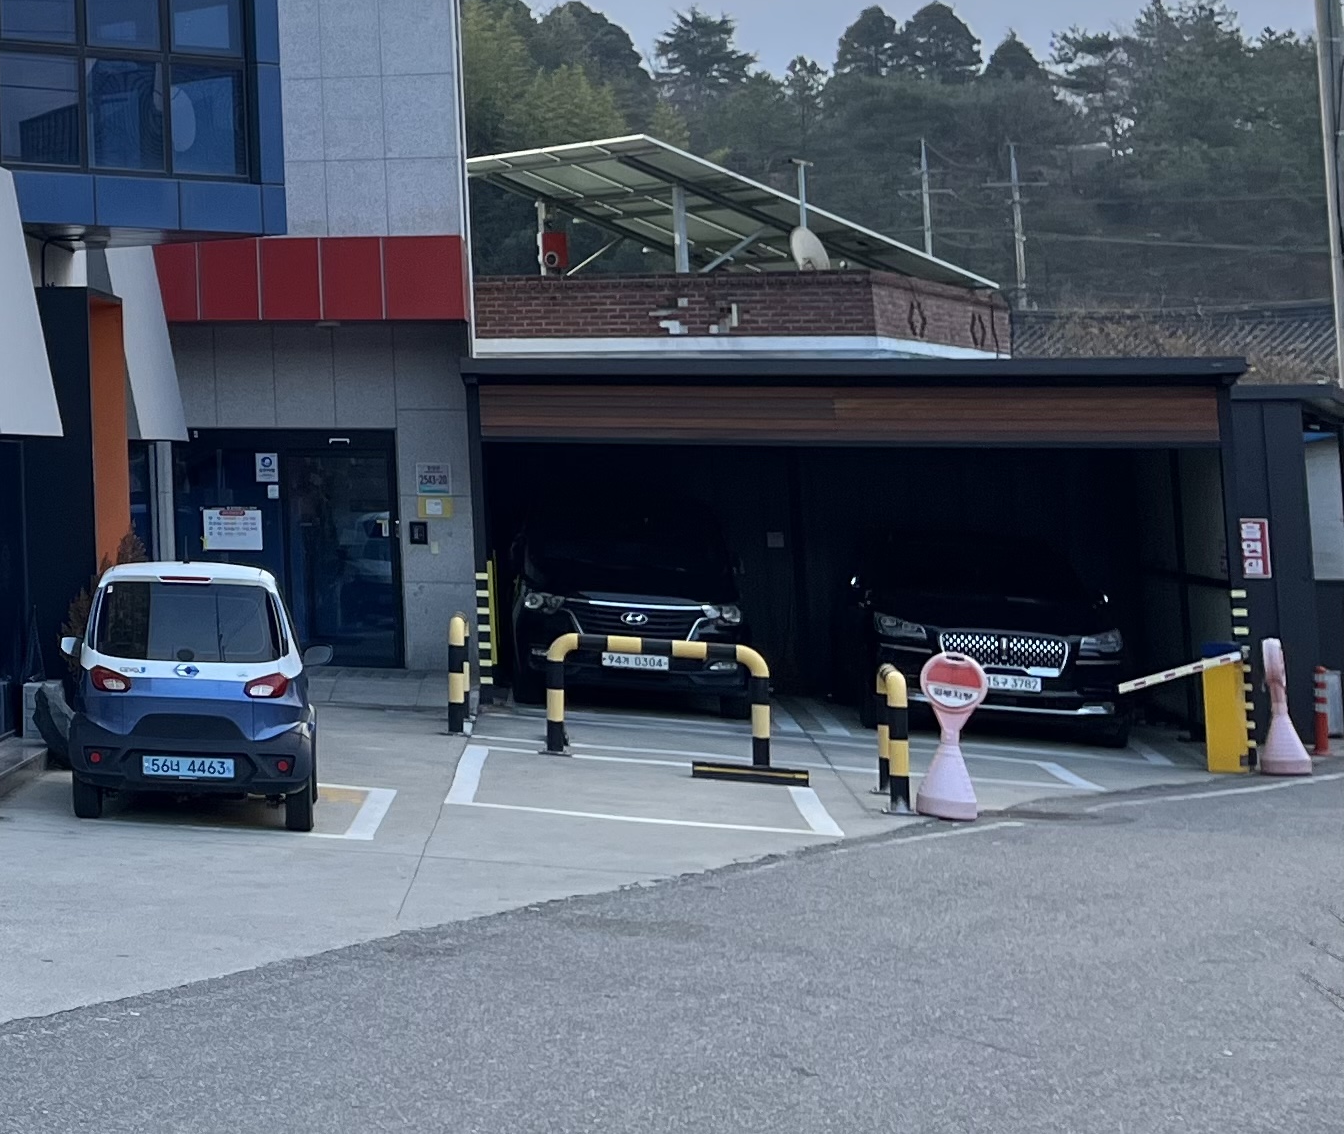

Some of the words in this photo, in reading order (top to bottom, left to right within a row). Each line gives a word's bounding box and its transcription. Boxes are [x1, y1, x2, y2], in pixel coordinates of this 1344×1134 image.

[634, 657, 663, 667] 0304
[151, 758, 180, 773] 56너
[187, 759, 226, 775] 4463
